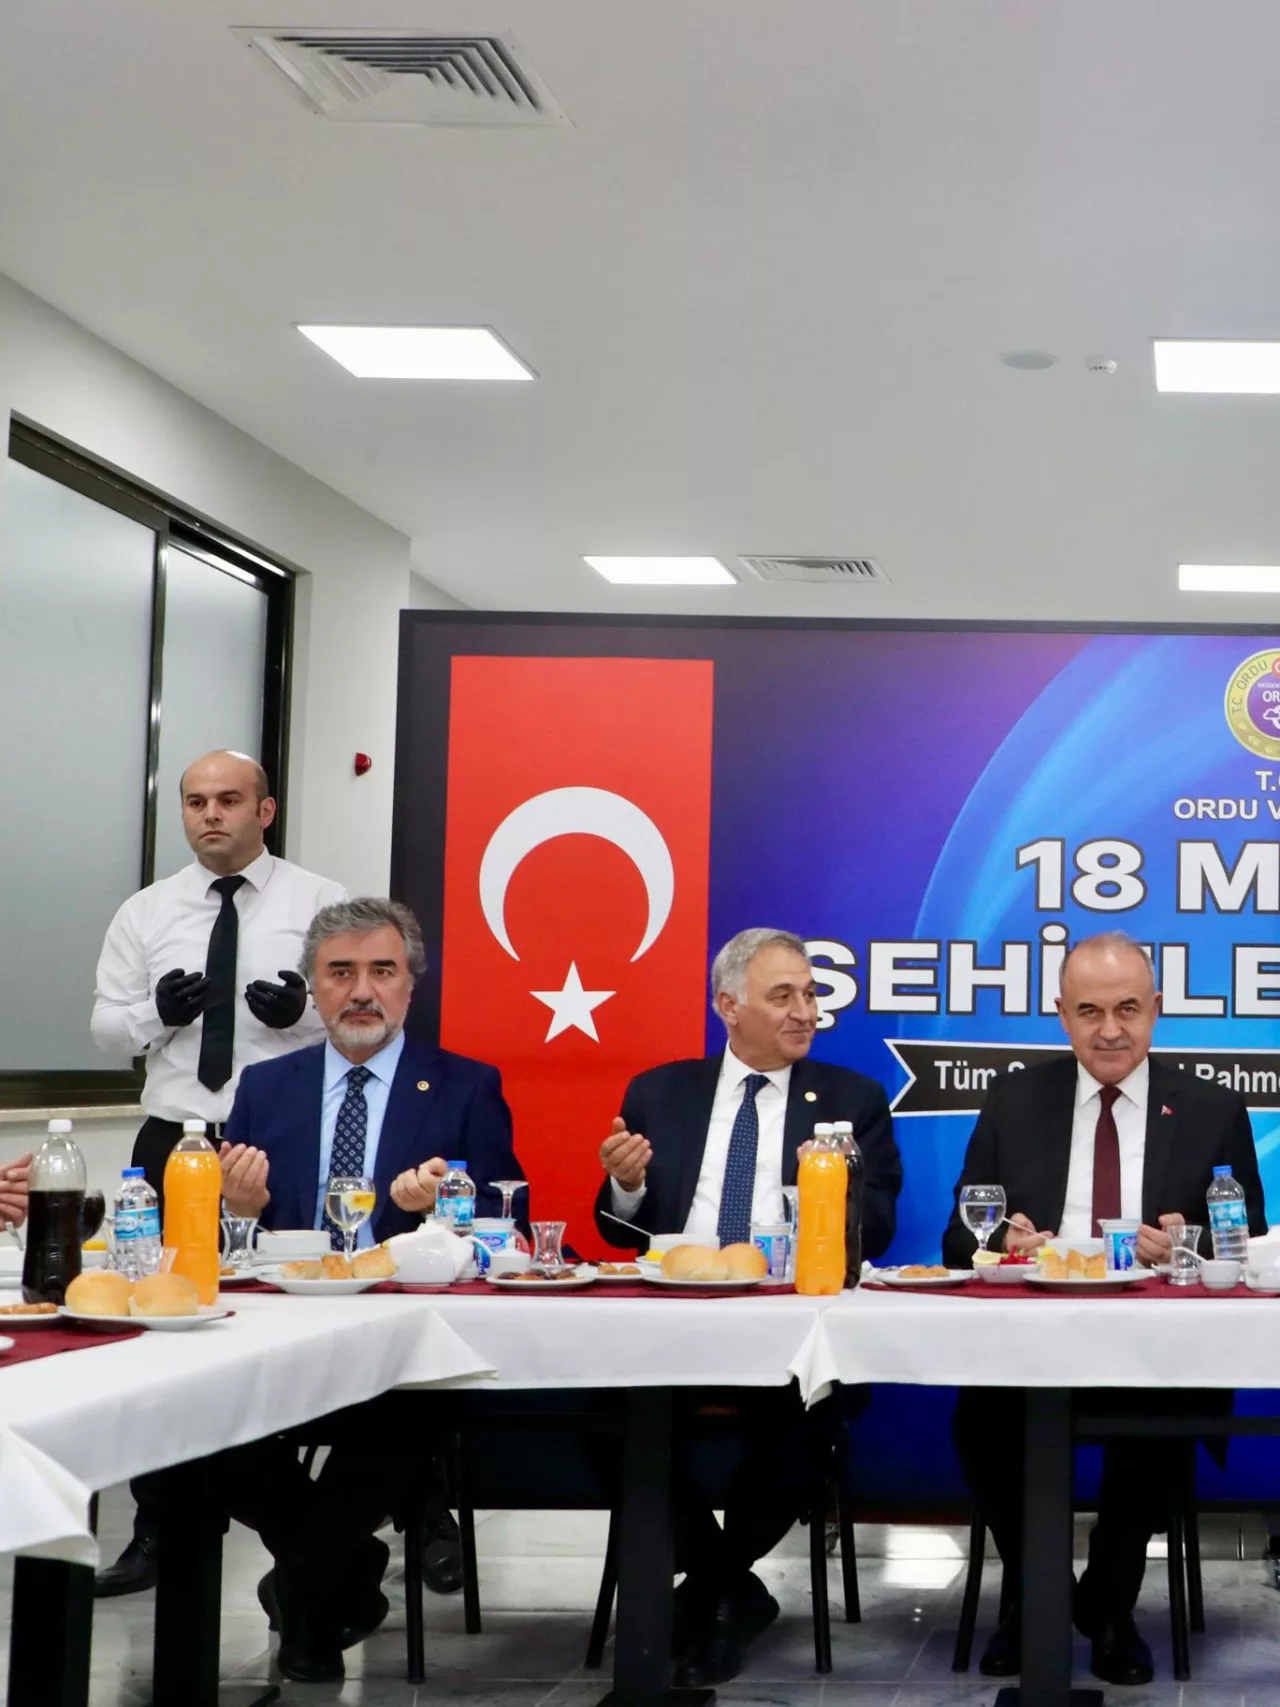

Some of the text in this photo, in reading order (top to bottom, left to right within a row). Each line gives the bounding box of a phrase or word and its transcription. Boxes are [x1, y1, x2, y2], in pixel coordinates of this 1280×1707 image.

[1236, 659, 1269, 692] ORDU
[1173, 798, 1258, 820] ORDU
[1015, 837, 1148, 913] 18
